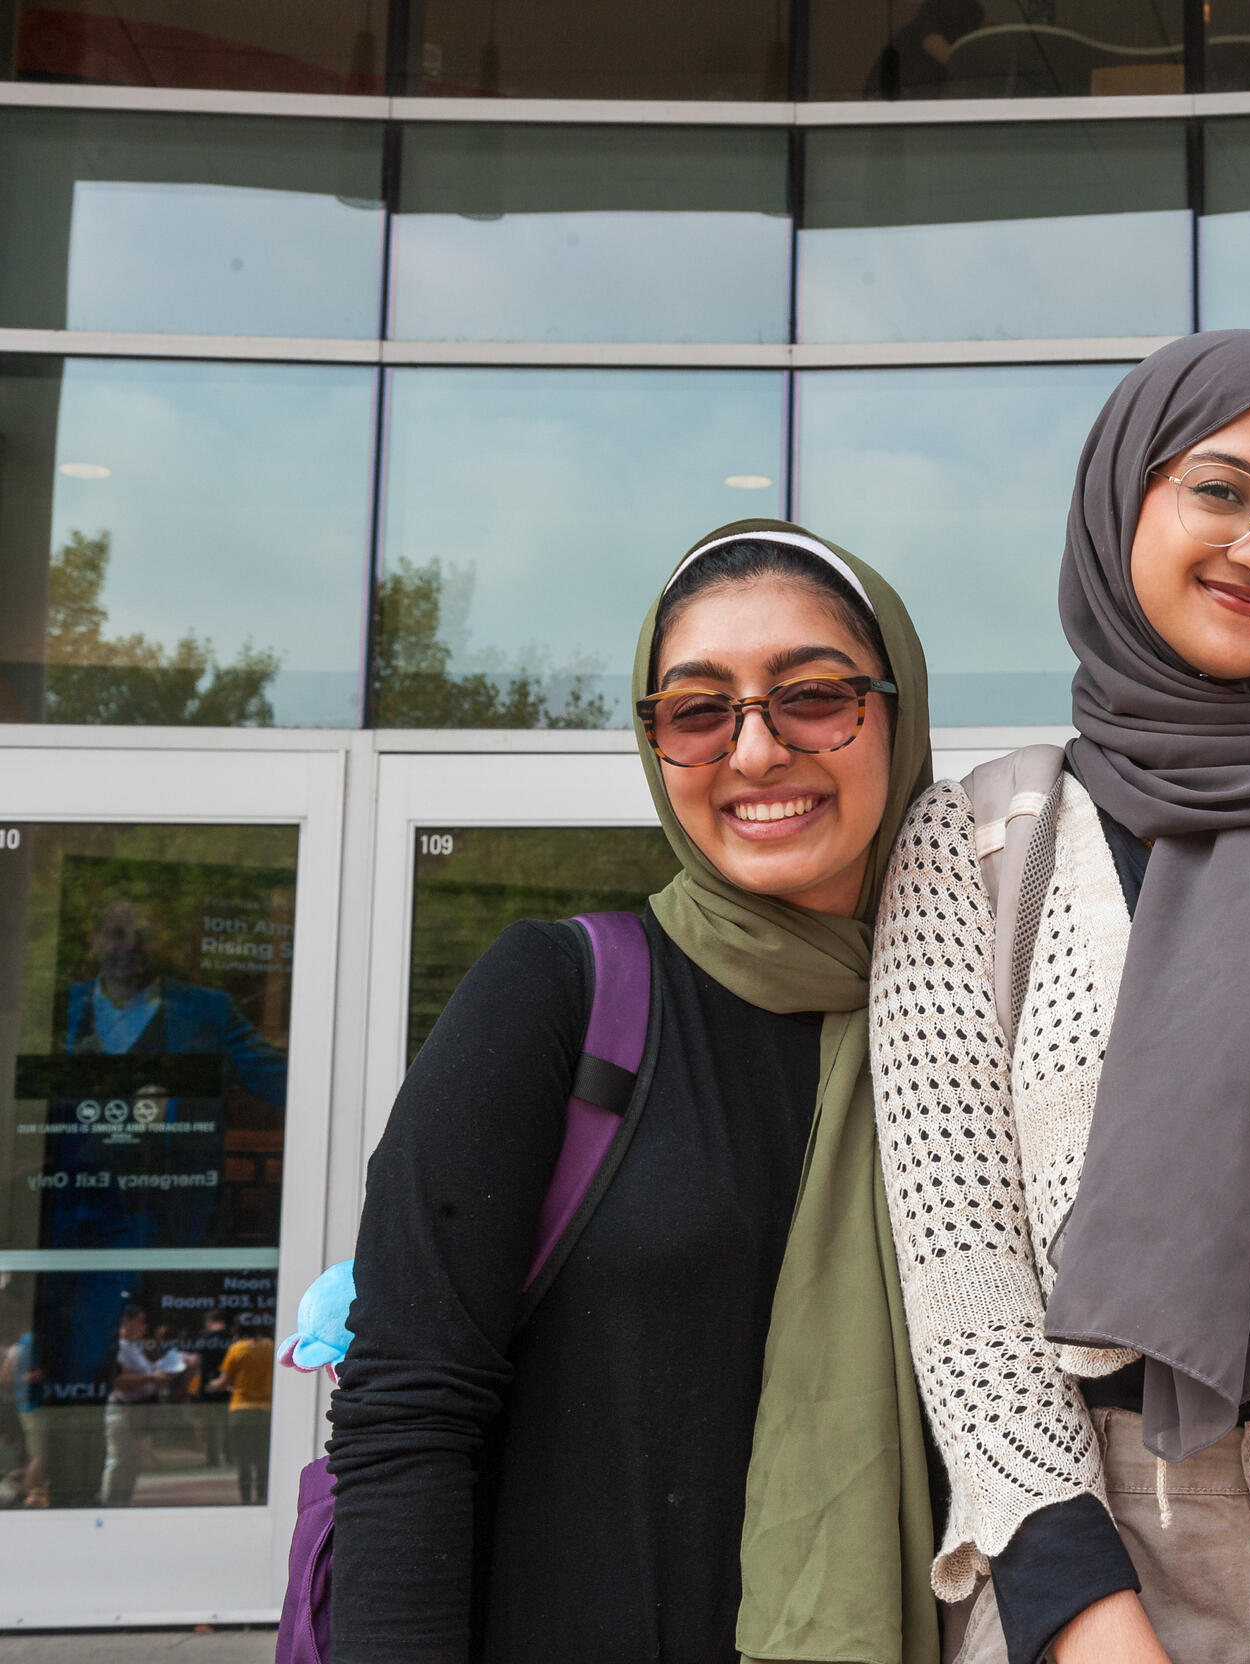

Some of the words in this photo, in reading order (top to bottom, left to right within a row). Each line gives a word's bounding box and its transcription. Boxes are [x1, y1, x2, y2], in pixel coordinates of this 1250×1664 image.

[420, 834, 454, 855] 109
[203, 916, 248, 933] 10th
[201, 936, 273, 960] Rising
[224, 1277, 271, 1291] Noon
[161, 1295, 215, 1309] Room
